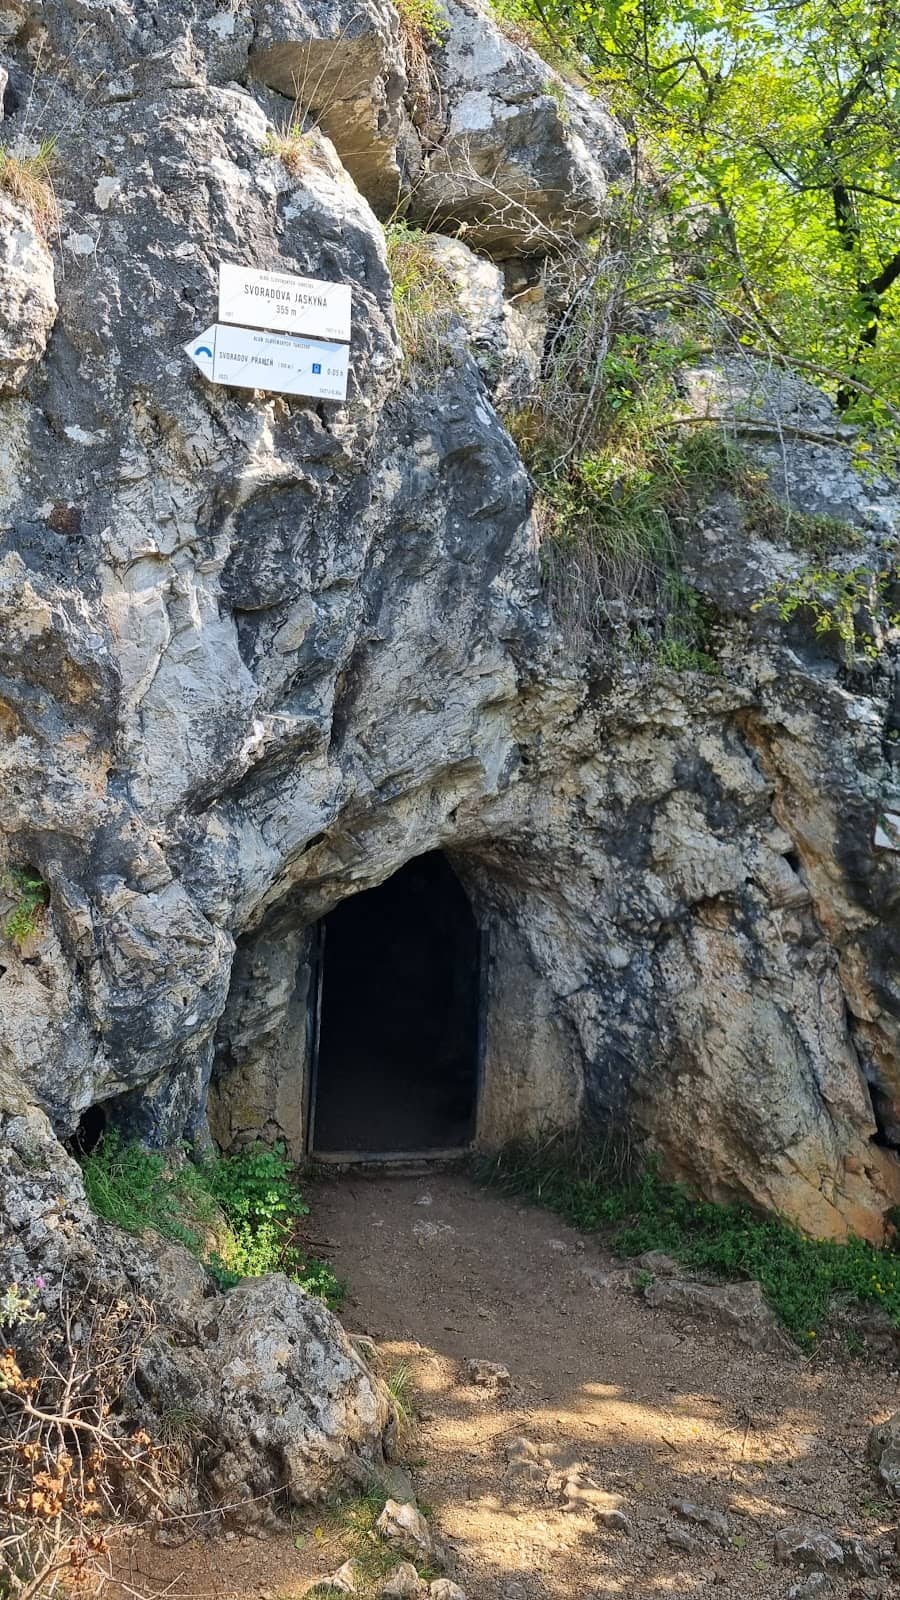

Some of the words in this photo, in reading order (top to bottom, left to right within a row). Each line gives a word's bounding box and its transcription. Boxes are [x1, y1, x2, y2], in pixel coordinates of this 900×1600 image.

[244, 284, 291, 302] SVORADOVA
[276, 304, 289, 315] 355
[290, 309, 297, 317] m
[219, 351, 249, 363] SVORADOV
